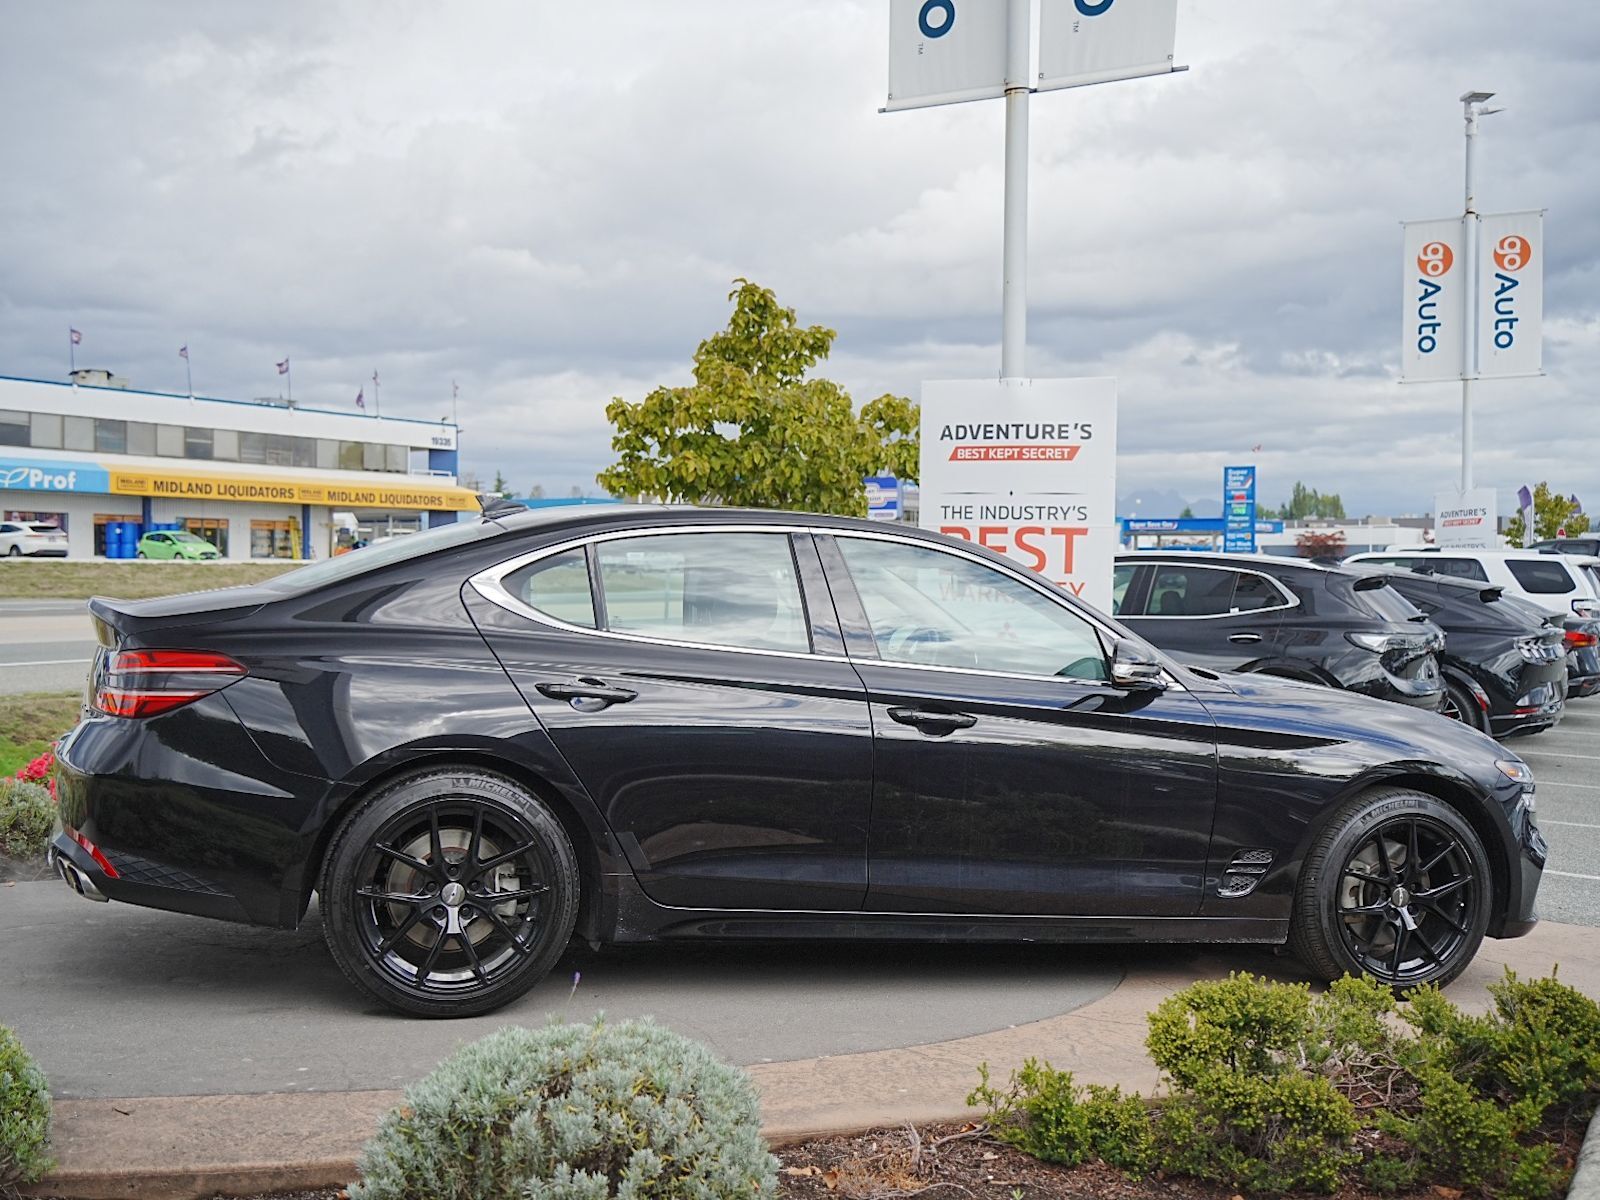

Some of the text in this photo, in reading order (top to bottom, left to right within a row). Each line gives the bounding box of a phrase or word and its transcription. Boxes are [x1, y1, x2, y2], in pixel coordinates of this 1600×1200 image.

[1418, 279, 1441, 353] Auto
[1495, 273, 1519, 348] Auto
[940, 423, 1092, 440] ADVENTURE'S
[957, 447, 1070, 459] BEST KEPT SECRET
[29, 468, 76, 489] Prof
[153, 480, 295, 499] MIDLAND LIQUIDATORS
[327, 490, 376, 503] MIDLAND
[379, 494, 443, 506] LIQUIDATORS
[941, 505, 1088, 520] THE INDUSTRY'S
[468, 780, 530, 810] MICHELIN
[1371, 800, 1419, 818] MICHELIN
